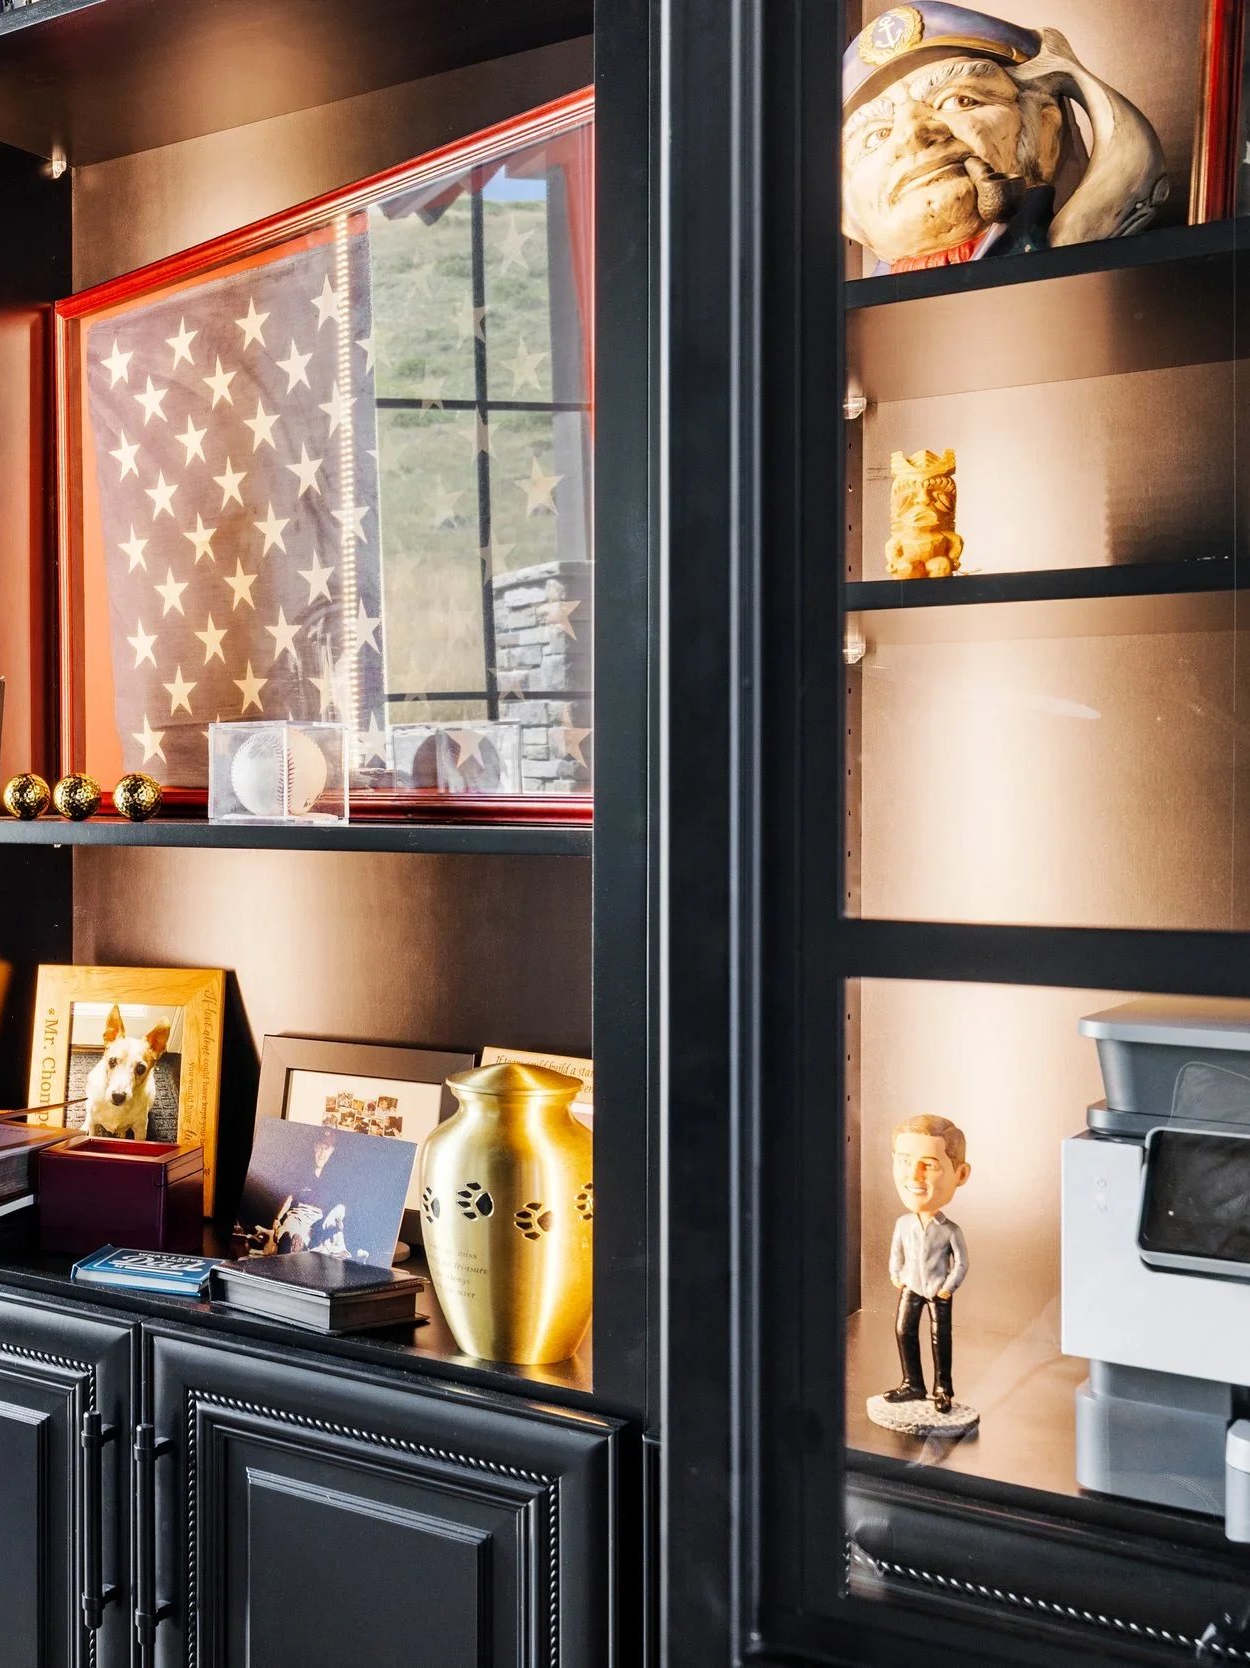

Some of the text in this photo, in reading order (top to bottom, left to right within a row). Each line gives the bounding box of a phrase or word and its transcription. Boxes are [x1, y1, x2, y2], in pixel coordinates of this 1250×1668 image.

[43, 1018, 59, 1051] Mr.
[187, 1062, 196, 1077] you
[203, 1058, 214, 1080] could
[187, 1078, 195, 1103] would
[201, 1081, 211, 1100] have
[186, 1104, 194, 1124] have
[200, 1102, 210, 1120] kept
[198, 1121, 208, 1137] you
[108, 1255, 207, 1272] Dad
[457, 1250, 478, 1260] miss
[454, 1263, 488, 1276] treasure
